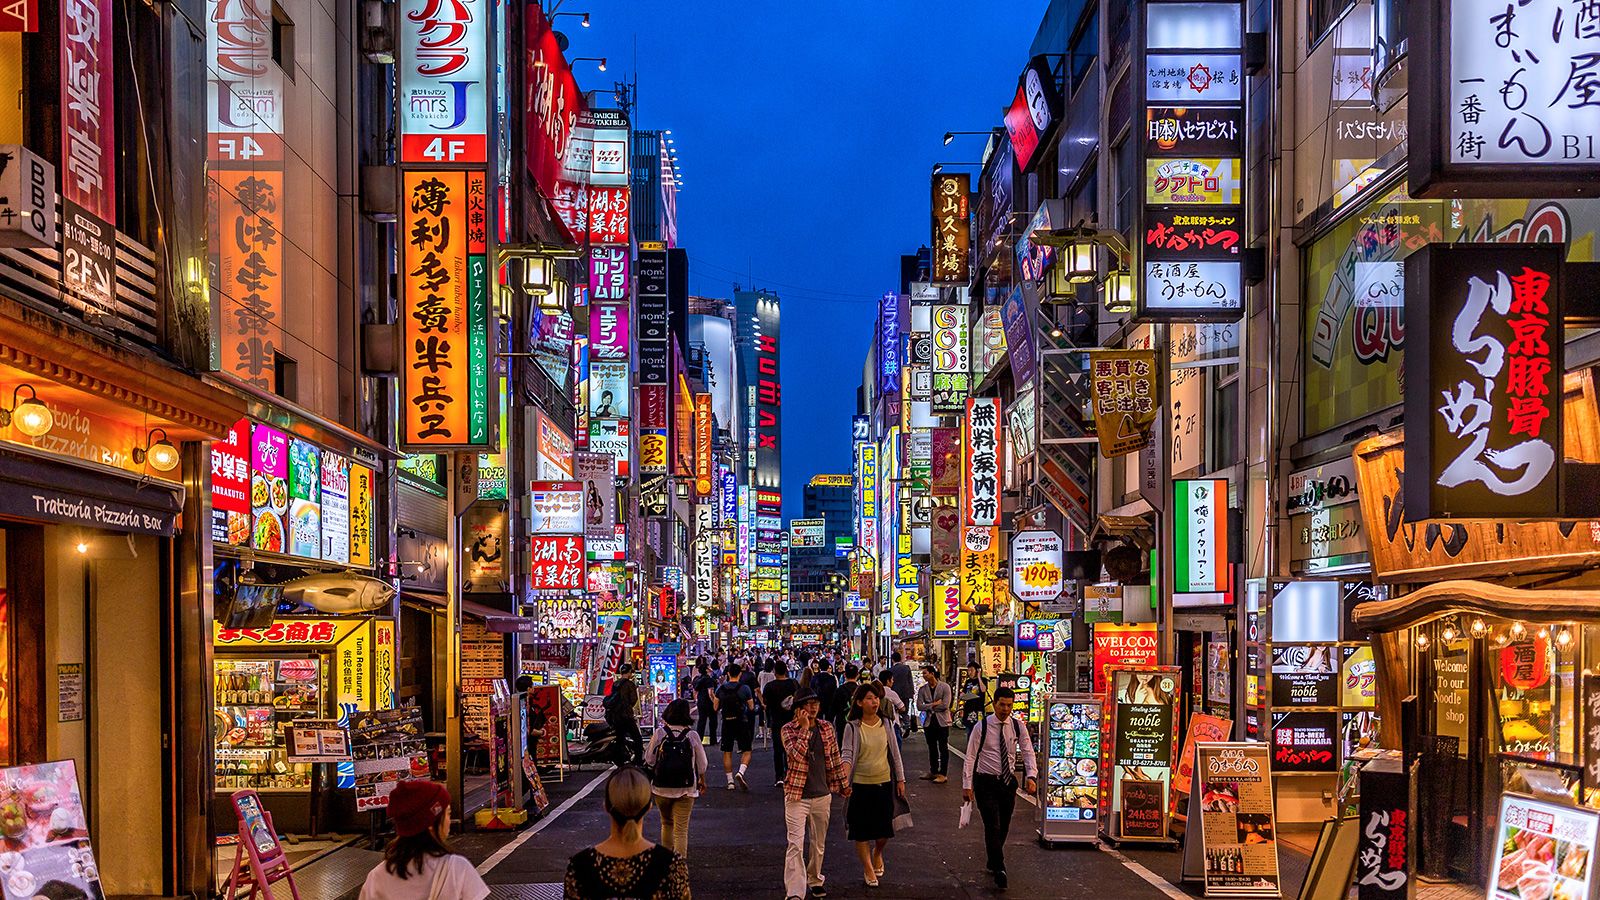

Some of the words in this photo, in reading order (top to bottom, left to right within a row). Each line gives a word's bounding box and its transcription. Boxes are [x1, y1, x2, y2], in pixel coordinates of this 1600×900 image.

[1490, 0, 1552, 158] まいもん
[1457, 77, 1487, 160] 一番街
[1149, 120, 1238, 140] 日本人セラピスト
[423, 137, 465, 161] 4F
[1154, 176, 1219, 193] クアトロ
[31, 159, 46, 237] BBQ
[590, 190, 628, 212] 湖南
[469, 179, 486, 243] 炭火串焼
[65, 248, 93, 283] 2F
[611, 248, 625, 299] レンタル
[1148, 263, 1201, 279] 居酒屋
[595, 262, 609, 299] ルーム
[1212, 299, 1238, 307] 一番街
[600, 306, 617, 343] エデン
[883, 292, 899, 391] カラオケの鉄人
[1506, 266, 1551, 437] 東京豚骨
[1095, 360, 1150, 377] 悪質な
[932, 373, 969, 391] 麻雀
[1097, 379, 1150, 396] 客引き
[1098, 396, 1153, 415] に注意
[591, 440, 628, 449] XROSS
[971, 403, 996, 520] 無料案内所
[725, 474, 735, 511] カラオケ
[33, 495, 92, 521] Trattoria
[94, 505, 140, 527] Pizzeria
[142, 514, 162, 530] Bar
[534, 503, 581, 512] マッサージ
[534, 538, 581, 565] 湖南
[592, 542, 619, 551] CASA
[1194, 506, 1209, 580] 俺のイタリアン
[965, 553, 982, 605] まっちゃん
[1025, 566, 1058, 581] 190円
[944, 586, 960, 629] クラウン
[356, 636, 364, 655] Tuna
[602, 629, 628, 682] PIZZA
[1110, 648, 1119, 656] to
[1120, 648, 1157, 658] Izakaya
[1433, 659, 1468, 673] Welcome
[356, 657, 364, 701] Restaurant
[1437, 676, 1448, 688] To
[1450, 678, 1465, 689] our
[1290, 685, 1318, 697] noble
[1433, 690, 1462, 705] Noodle
[1130, 714, 1161, 727] noble
[1445, 708, 1465, 724] shop
